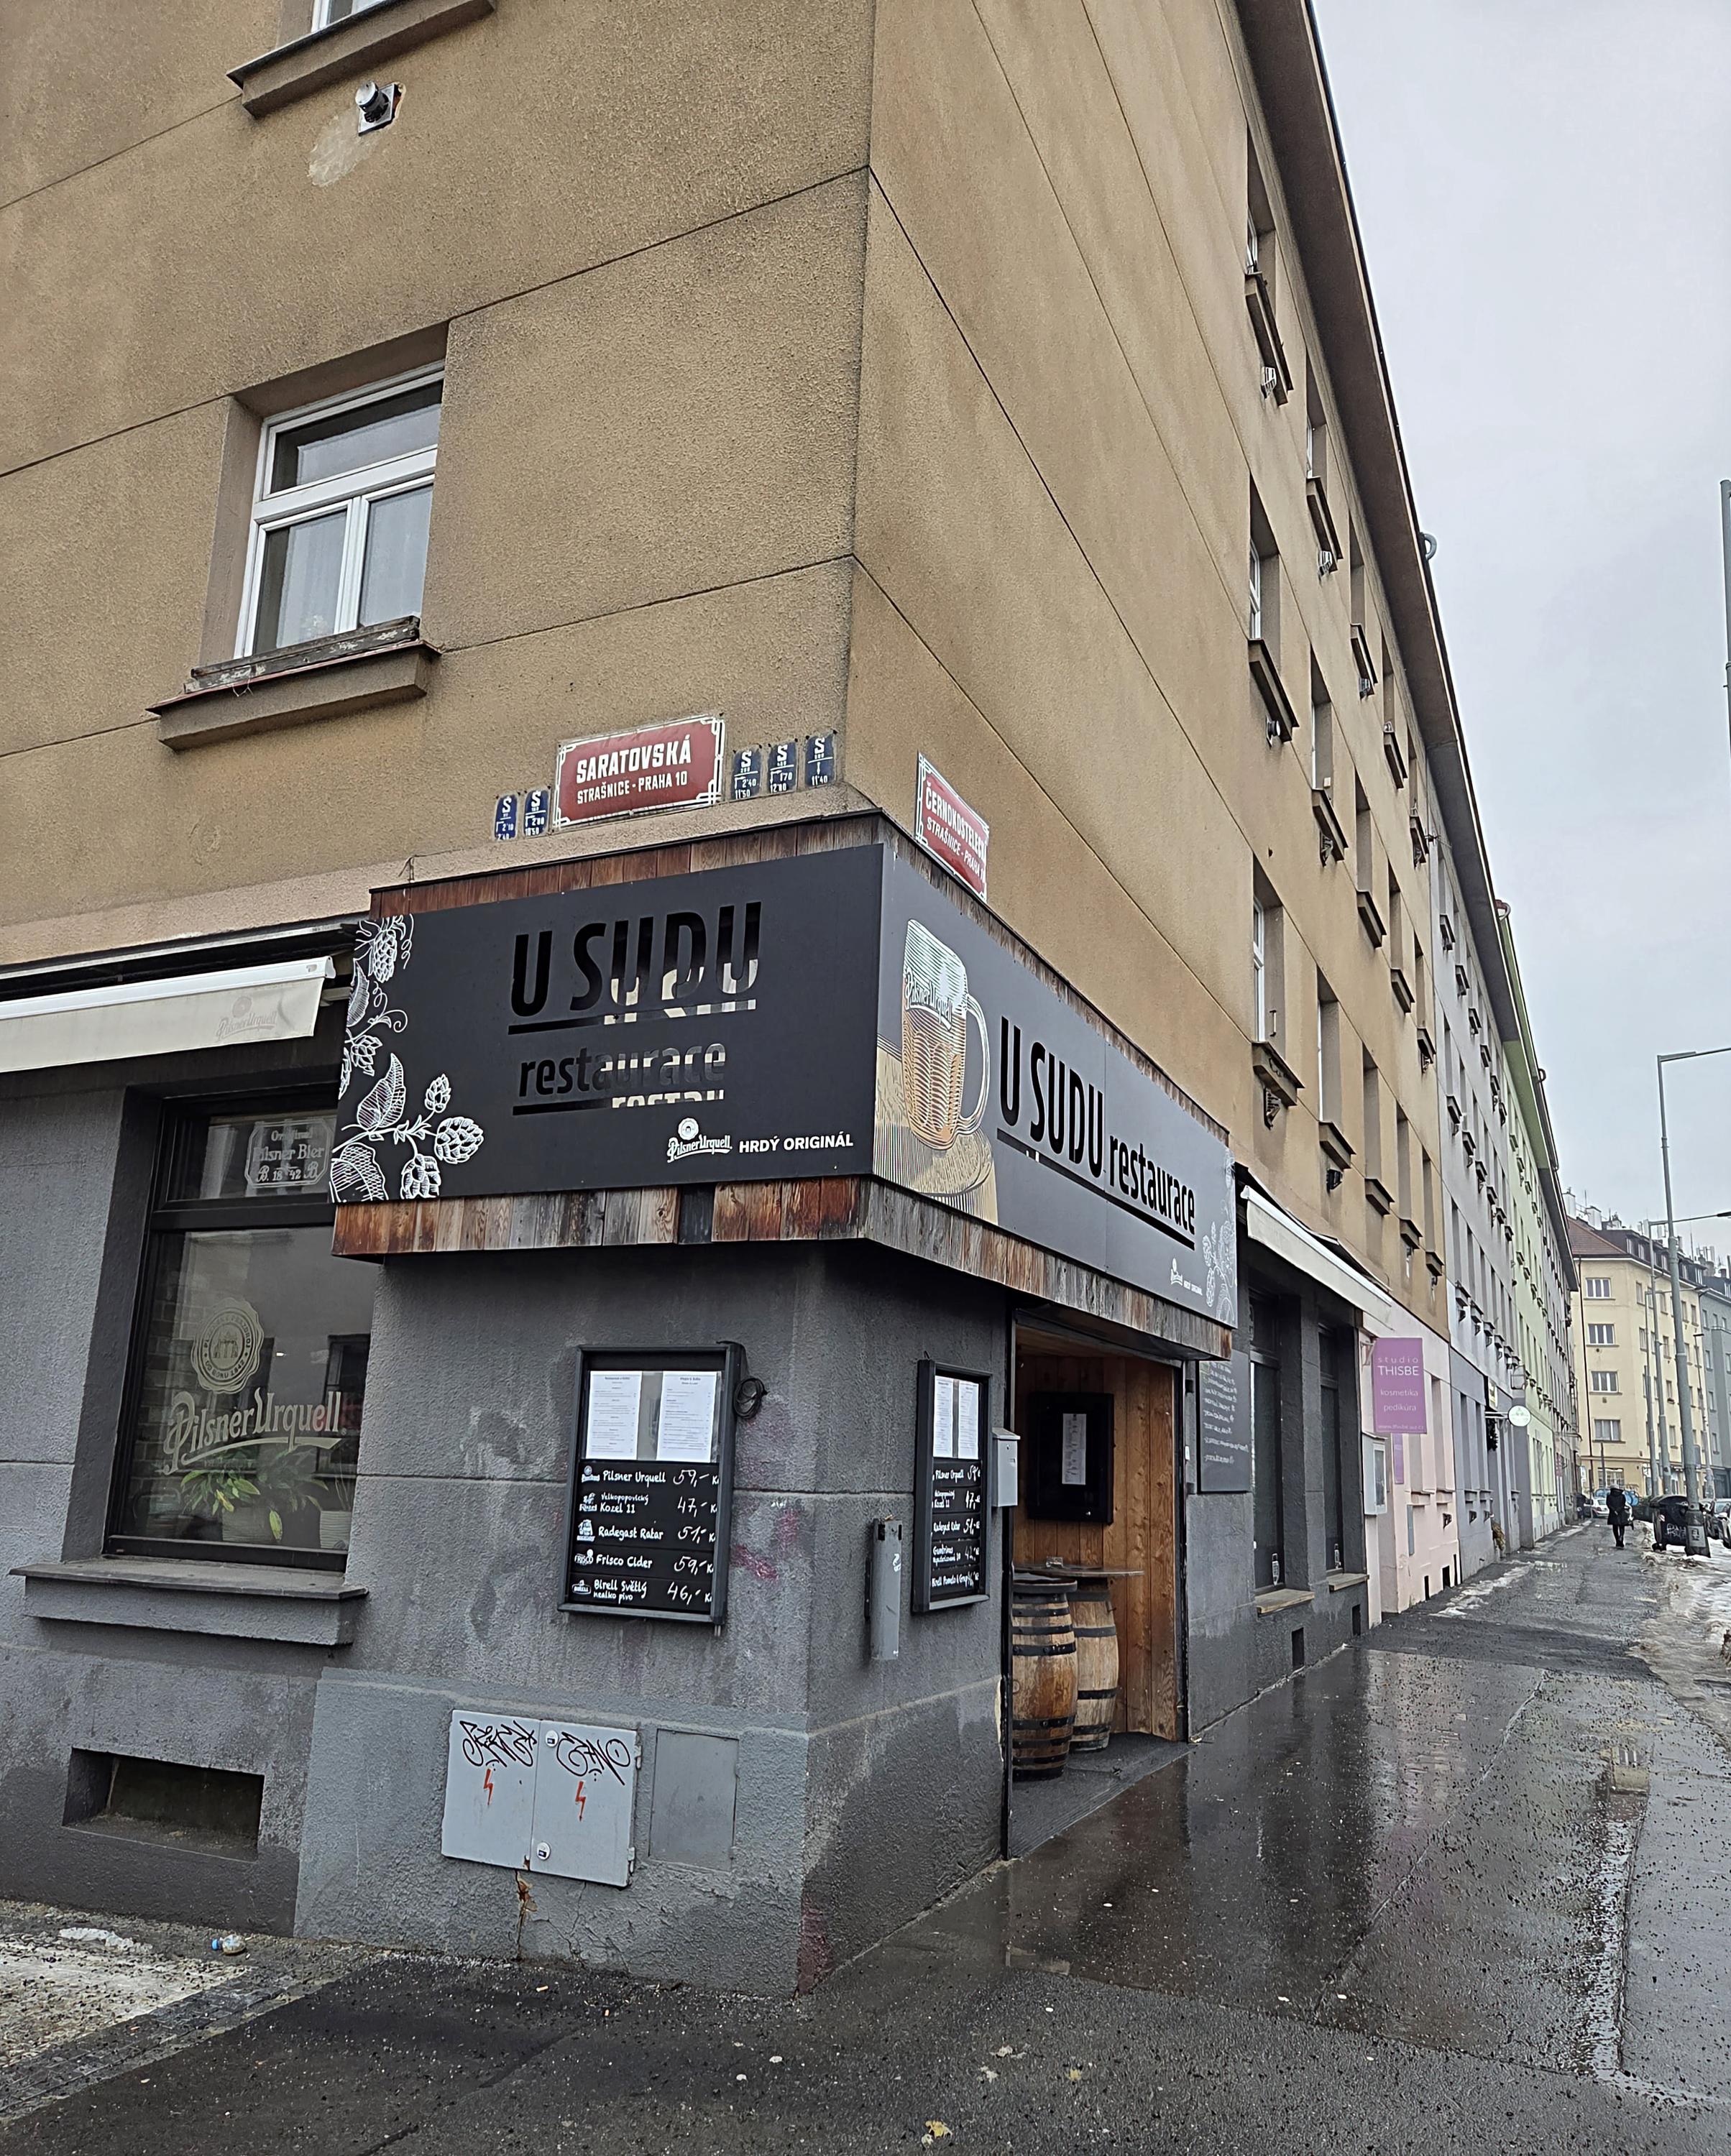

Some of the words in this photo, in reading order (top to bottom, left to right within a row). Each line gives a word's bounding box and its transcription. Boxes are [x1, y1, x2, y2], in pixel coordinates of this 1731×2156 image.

[577, 734, 691, 783] SARATOVSKÁ
[577, 780, 630, 804] STRAŠNICE
[638, 773, 672, 792] PRAHA
[676, 771, 687, 786] 10
[927, 816, 961, 856] STRAŠNICE
[964, 849, 980, 877] PRAHA
[511, 931, 552, 1017] U
[569, 901, 761, 1010] SUDU
[519, 1044, 726, 1097] restaurace
[1000, 1015, 1021, 1127] U
[1030, 1041, 1103, 1178] SUDU
[1109, 1135, 1195, 1235] restaurace
[667, 1137, 699, 1163] Pilsner
[699, 1133, 733, 1155] Urquell
[739, 1136, 780, 1153] HRDÝ
[783, 1131, 853, 1150] ORIGINÁL
[1377, 1365, 1420, 1376] THISBE
[164, 1391, 254, 1475] Pilsner
[252, 1388, 342, 1452] Urquell
[603, 1470, 632, 1483] Pilsner
[635, 1471, 666, 1488] Urquell
[600, 1502, 623, 1514] Kozel
[626, 1504, 635, 1514] 11
[598, 1525, 637, 1542] Radegast
[640, 1528, 664, 1539] Ratar
[596, 1554, 624, 1566] Frisco
[627, 1556, 653, 1569] Cider
[593, 1590, 617, 1600] nealko
[619, 1592, 633, 1604] pivo
[594, 1579, 618, 1590] Birell
[621, 1580, 647, 1598] Světlý
